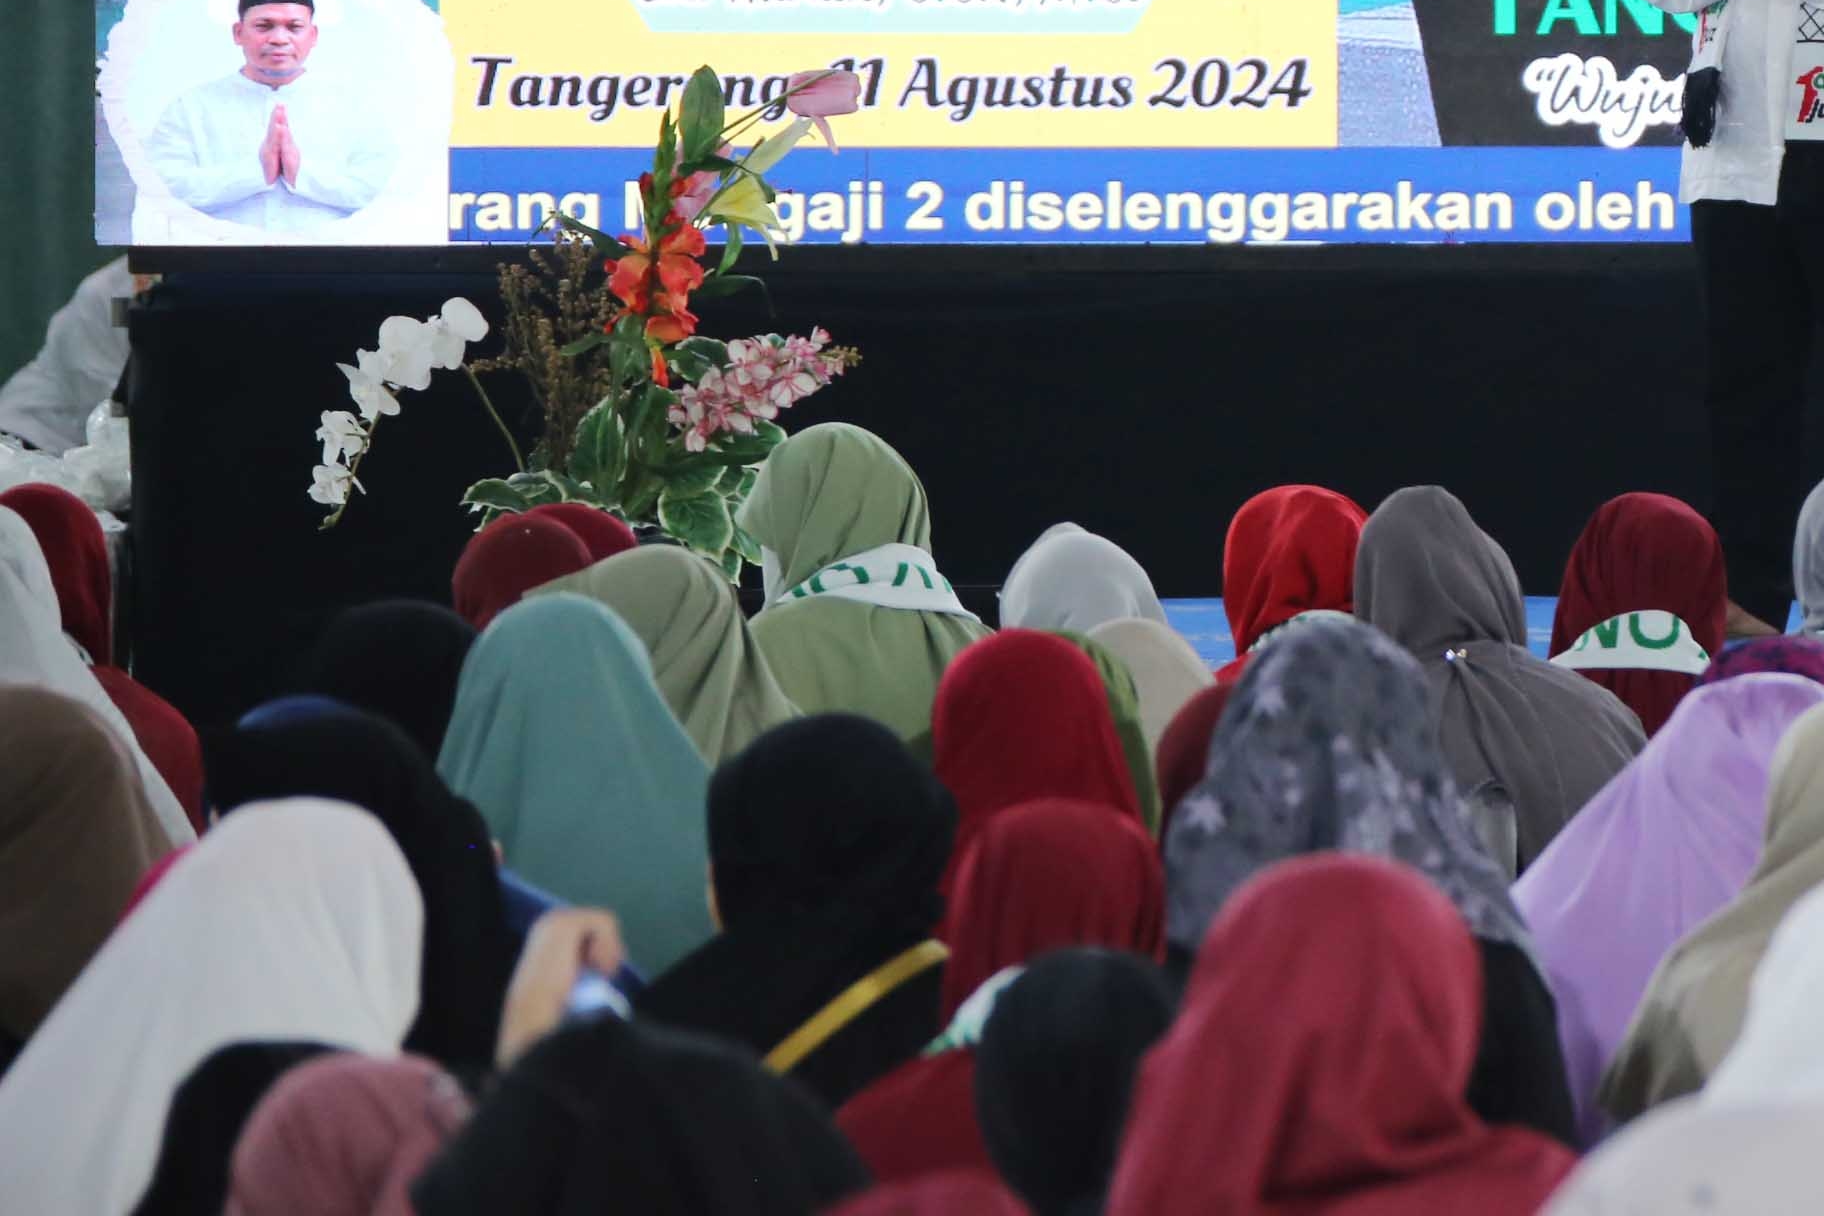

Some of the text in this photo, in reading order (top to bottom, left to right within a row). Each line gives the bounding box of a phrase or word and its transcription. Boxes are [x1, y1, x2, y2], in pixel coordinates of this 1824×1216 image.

[471, 57, 790, 121] Tangerng
[899, 59, 1134, 121] Agustus
[1147, 58, 1312, 108] 2024
[904, 180, 944, 231] 2
[963, 180, 1512, 244] diselenggarakan
[1535, 181, 1674, 231] oleh
